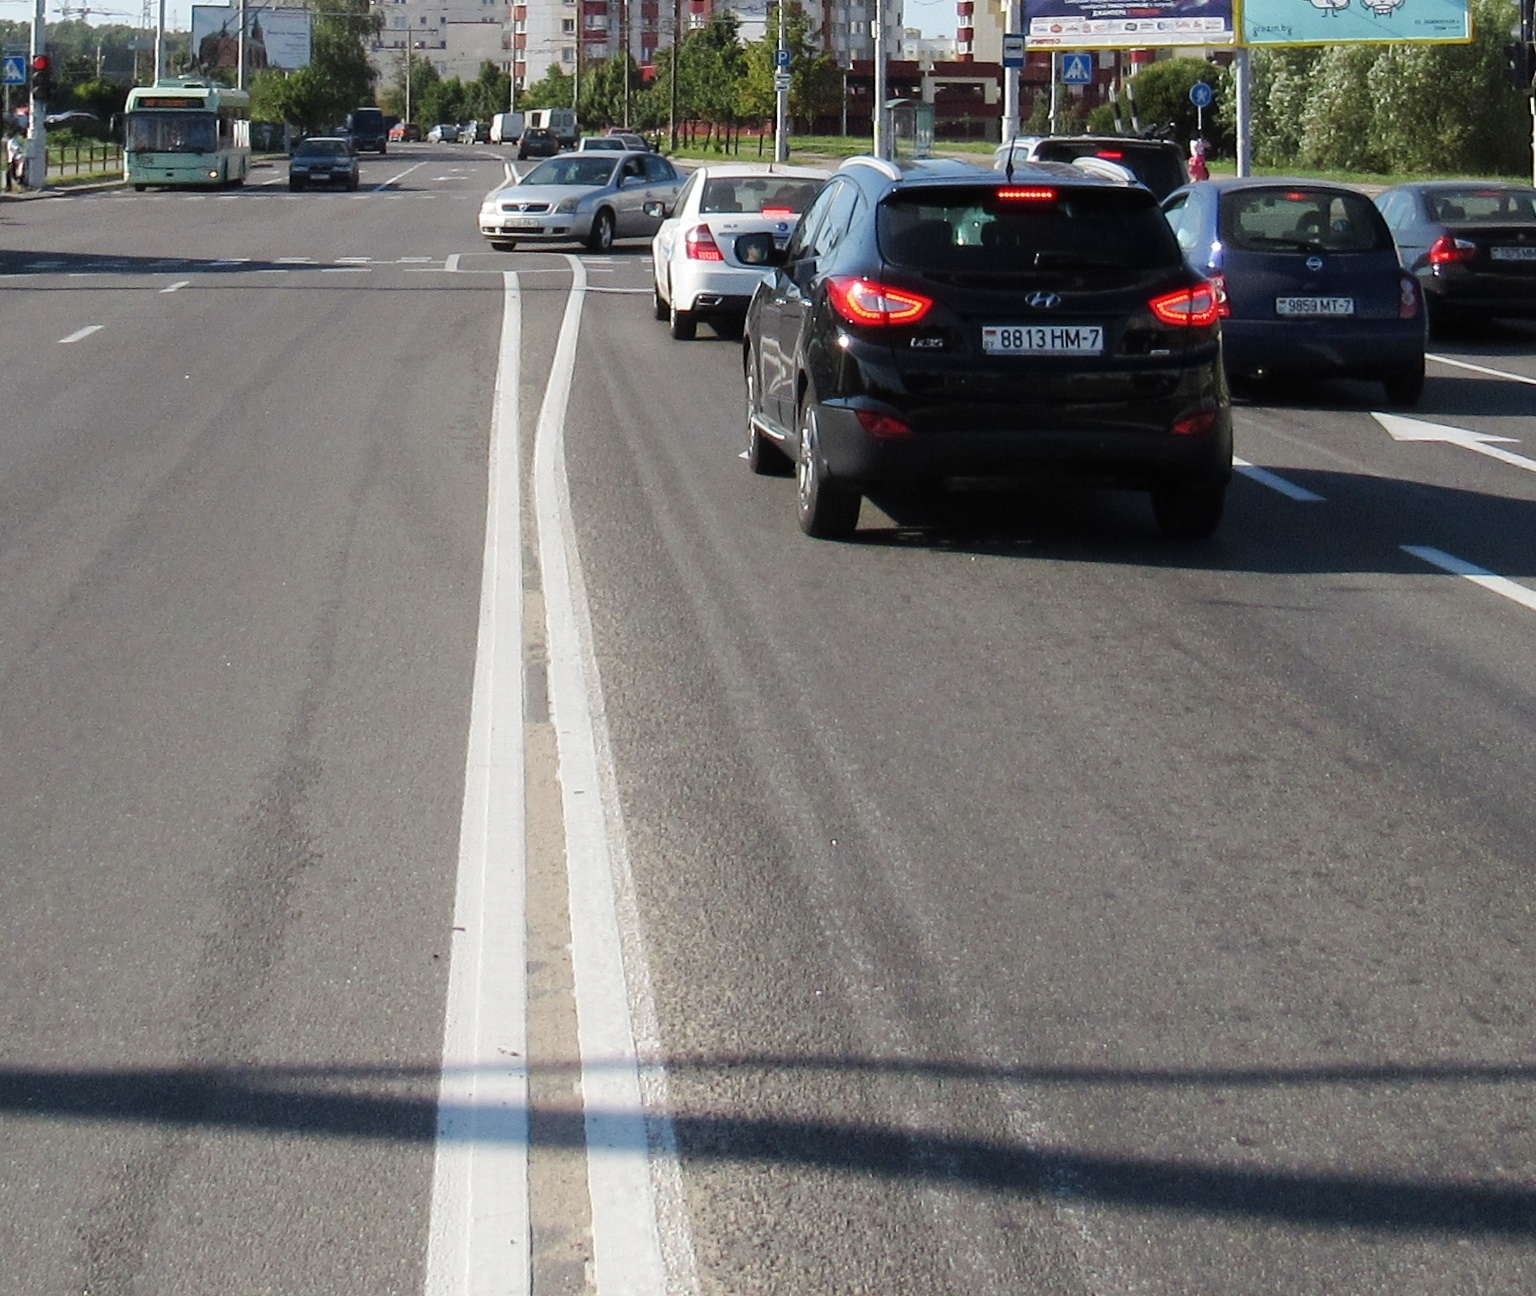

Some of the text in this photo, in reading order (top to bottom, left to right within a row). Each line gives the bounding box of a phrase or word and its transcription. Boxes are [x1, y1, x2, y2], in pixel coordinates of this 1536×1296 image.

[778, 51, 788, 64] P
[1320, 299, 1351, 312] MT-7
[1000, 329, 1046, 349] 8813
[1050, 328, 1100, 349] HM-7
